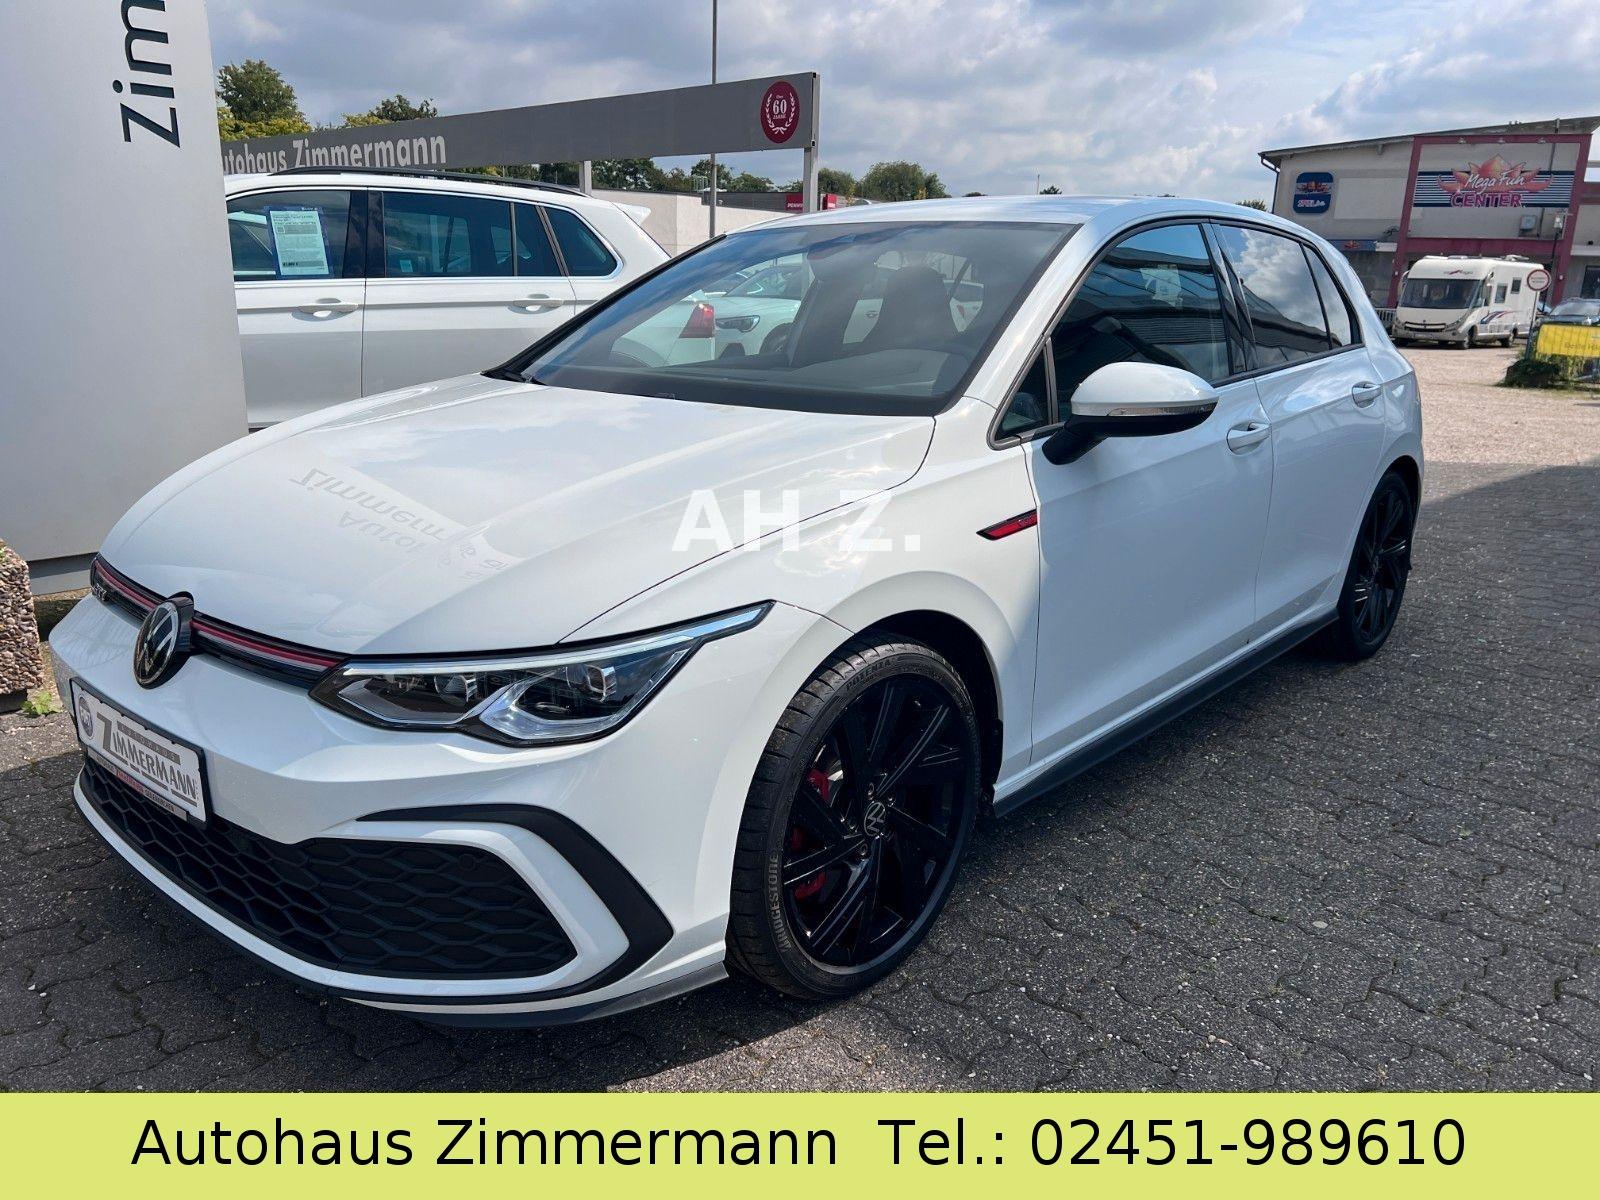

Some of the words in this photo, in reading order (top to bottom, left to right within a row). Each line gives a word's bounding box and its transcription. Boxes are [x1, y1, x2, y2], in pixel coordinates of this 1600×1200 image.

[113, 0, 180, 148] Zim
[772, 99, 788, 115] 60
[292, 135, 447, 169] Zimmermann
[1464, 173, 1496, 194] Mega
[1497, 169, 1526, 186] Fun
[1450, 191, 1523, 208] CENTER
[97, 711, 198, 803] ZIMMERMANN
